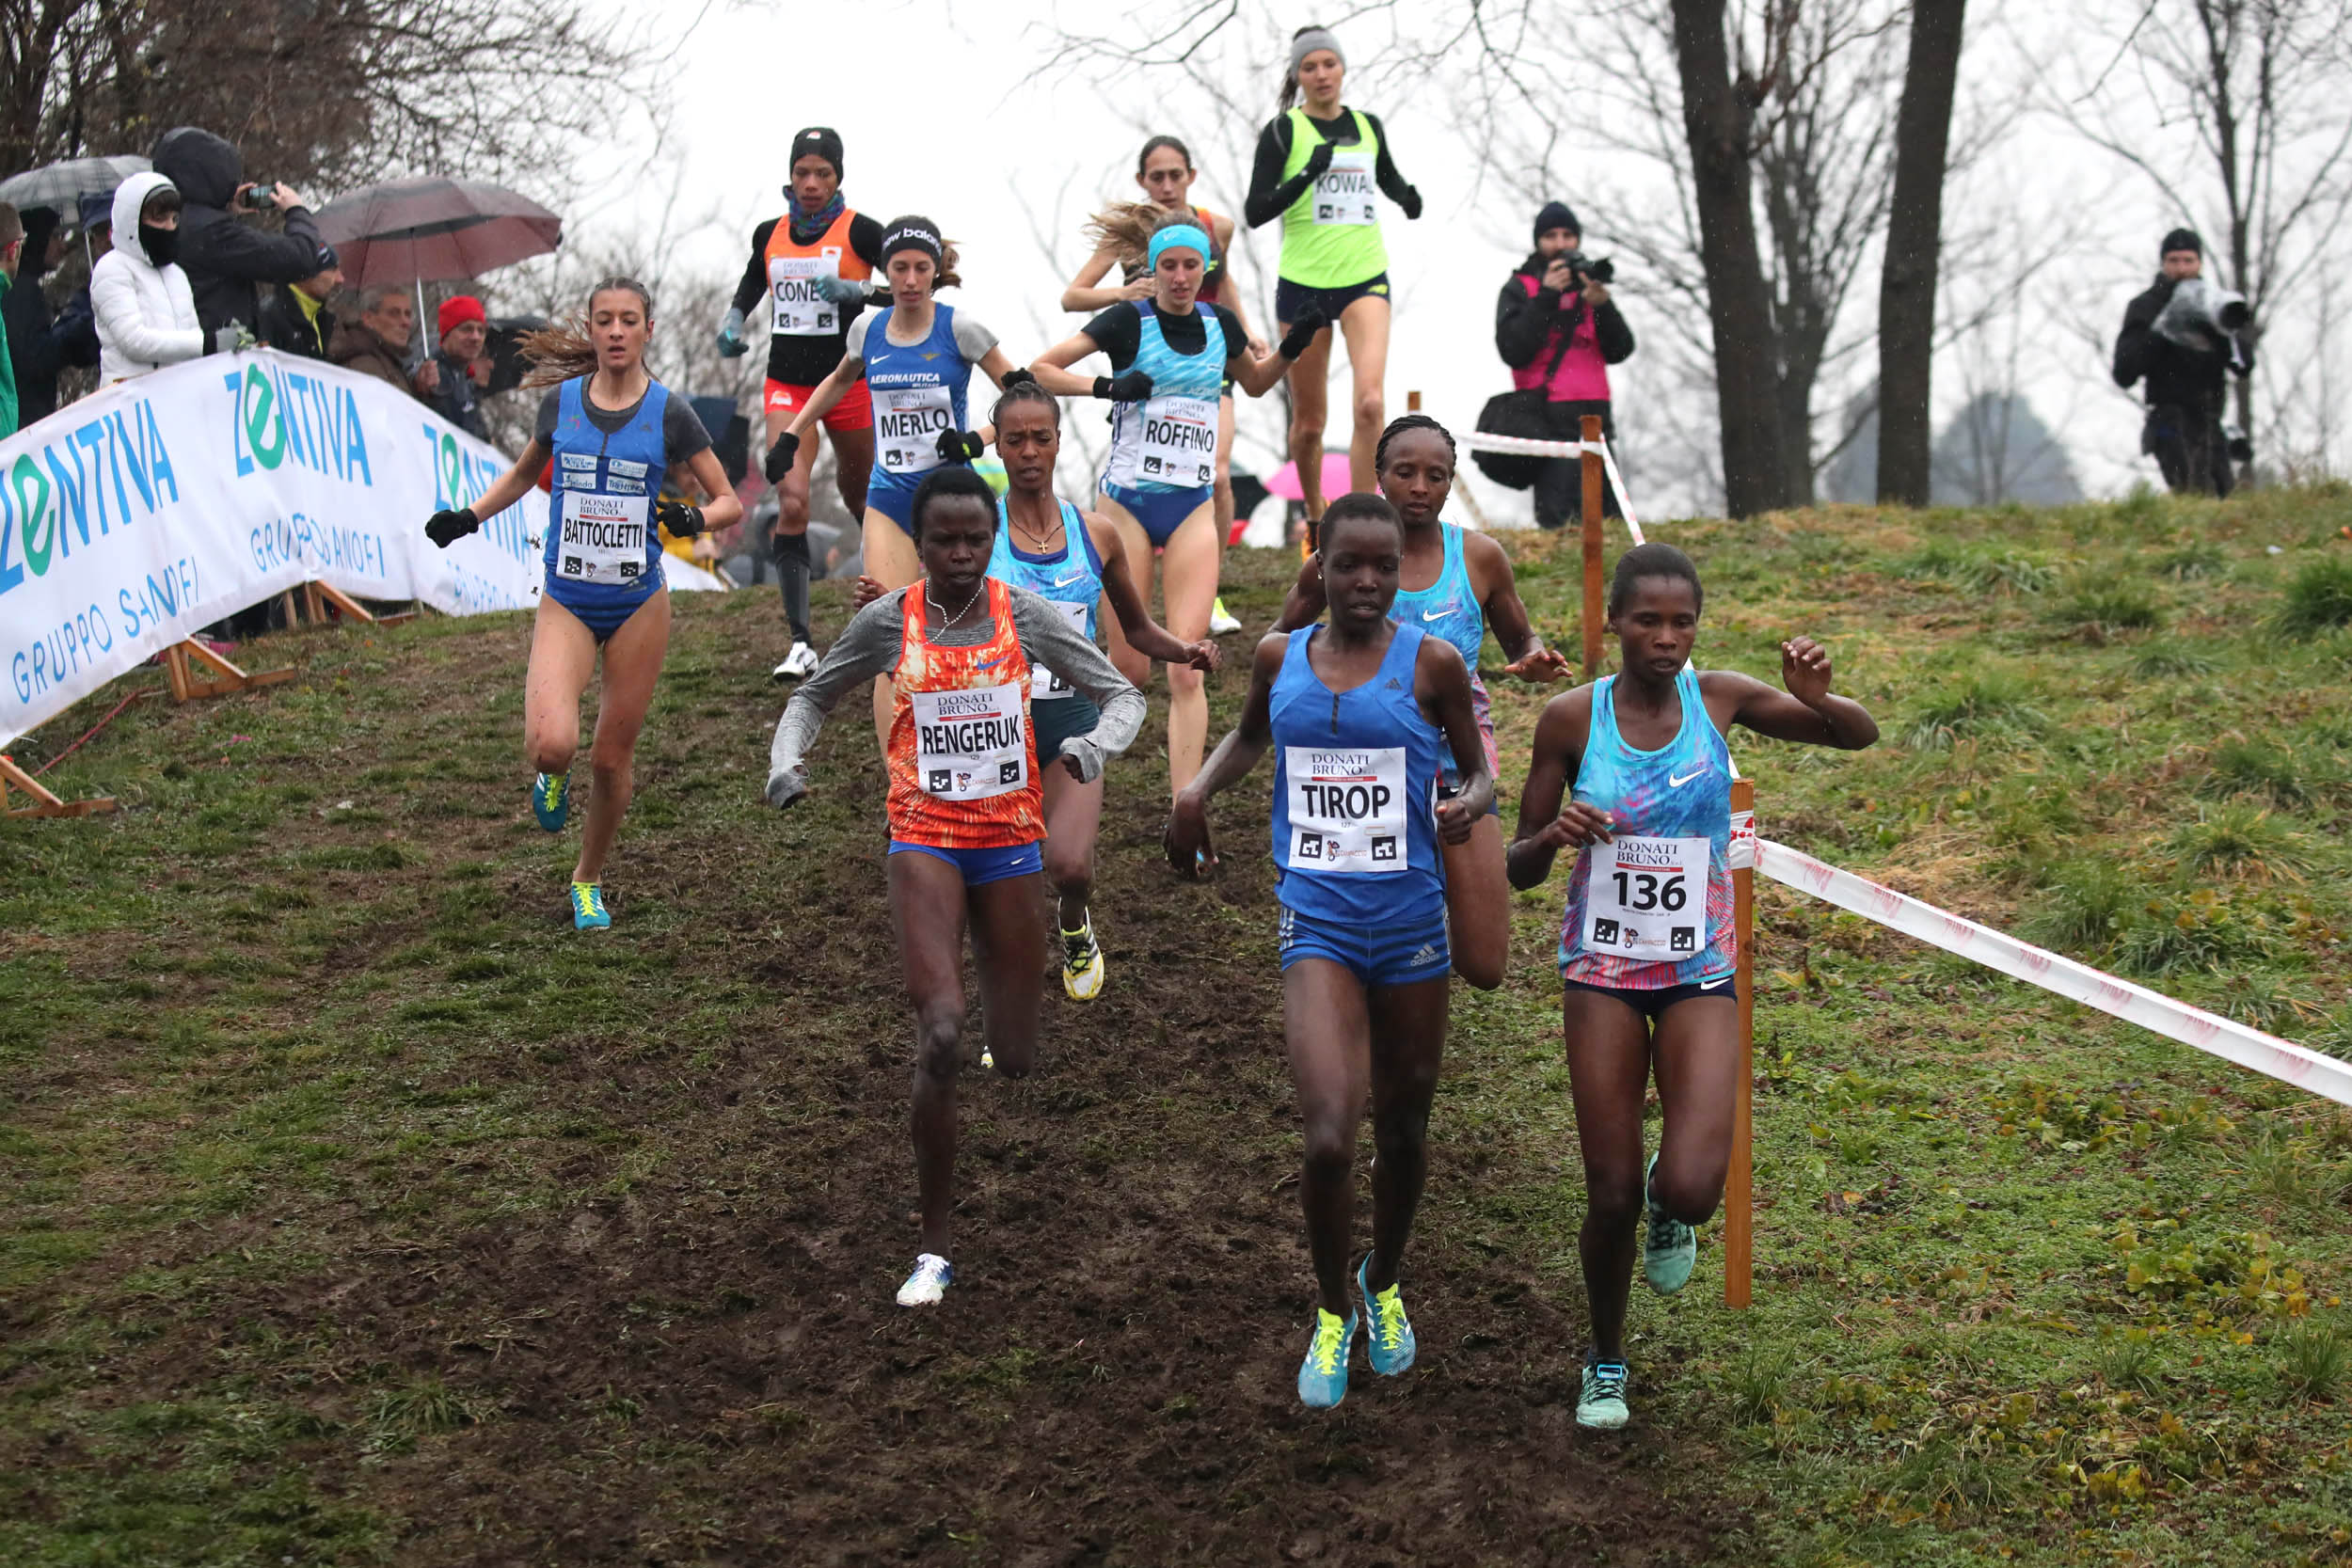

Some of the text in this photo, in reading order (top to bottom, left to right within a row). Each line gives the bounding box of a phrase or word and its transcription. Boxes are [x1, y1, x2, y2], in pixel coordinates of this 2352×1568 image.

[903, 228, 942, 256] balan
[775, 281, 820, 302] CONE
[870, 372, 941, 385] AERONAUTICA
[881, 408, 949, 438] MERLO
[1145, 420, 1215, 453] ROFFINO
[580, 498, 624, 509] DONATI
[580, 507, 618, 515] BRUNO
[564, 517, 644, 548] BATTOCLETTI
[12, 603, 113, 705] GRUPPO
[937, 693, 993, 706] DONATI
[939, 703, 988, 716] BRUNO
[921, 714, 1021, 754] RENGERUK
[1311, 753, 1369, 765] DONATI
[1312, 765, 1362, 776] BRUNO
[1301, 784, 1391, 819] TIROP
[1618, 839, 1678, 855] DONATI
[1617, 850, 1670, 865] BRUNO
[1612, 871, 1687, 911] 136
[1410, 953, 1440, 967] adidas
